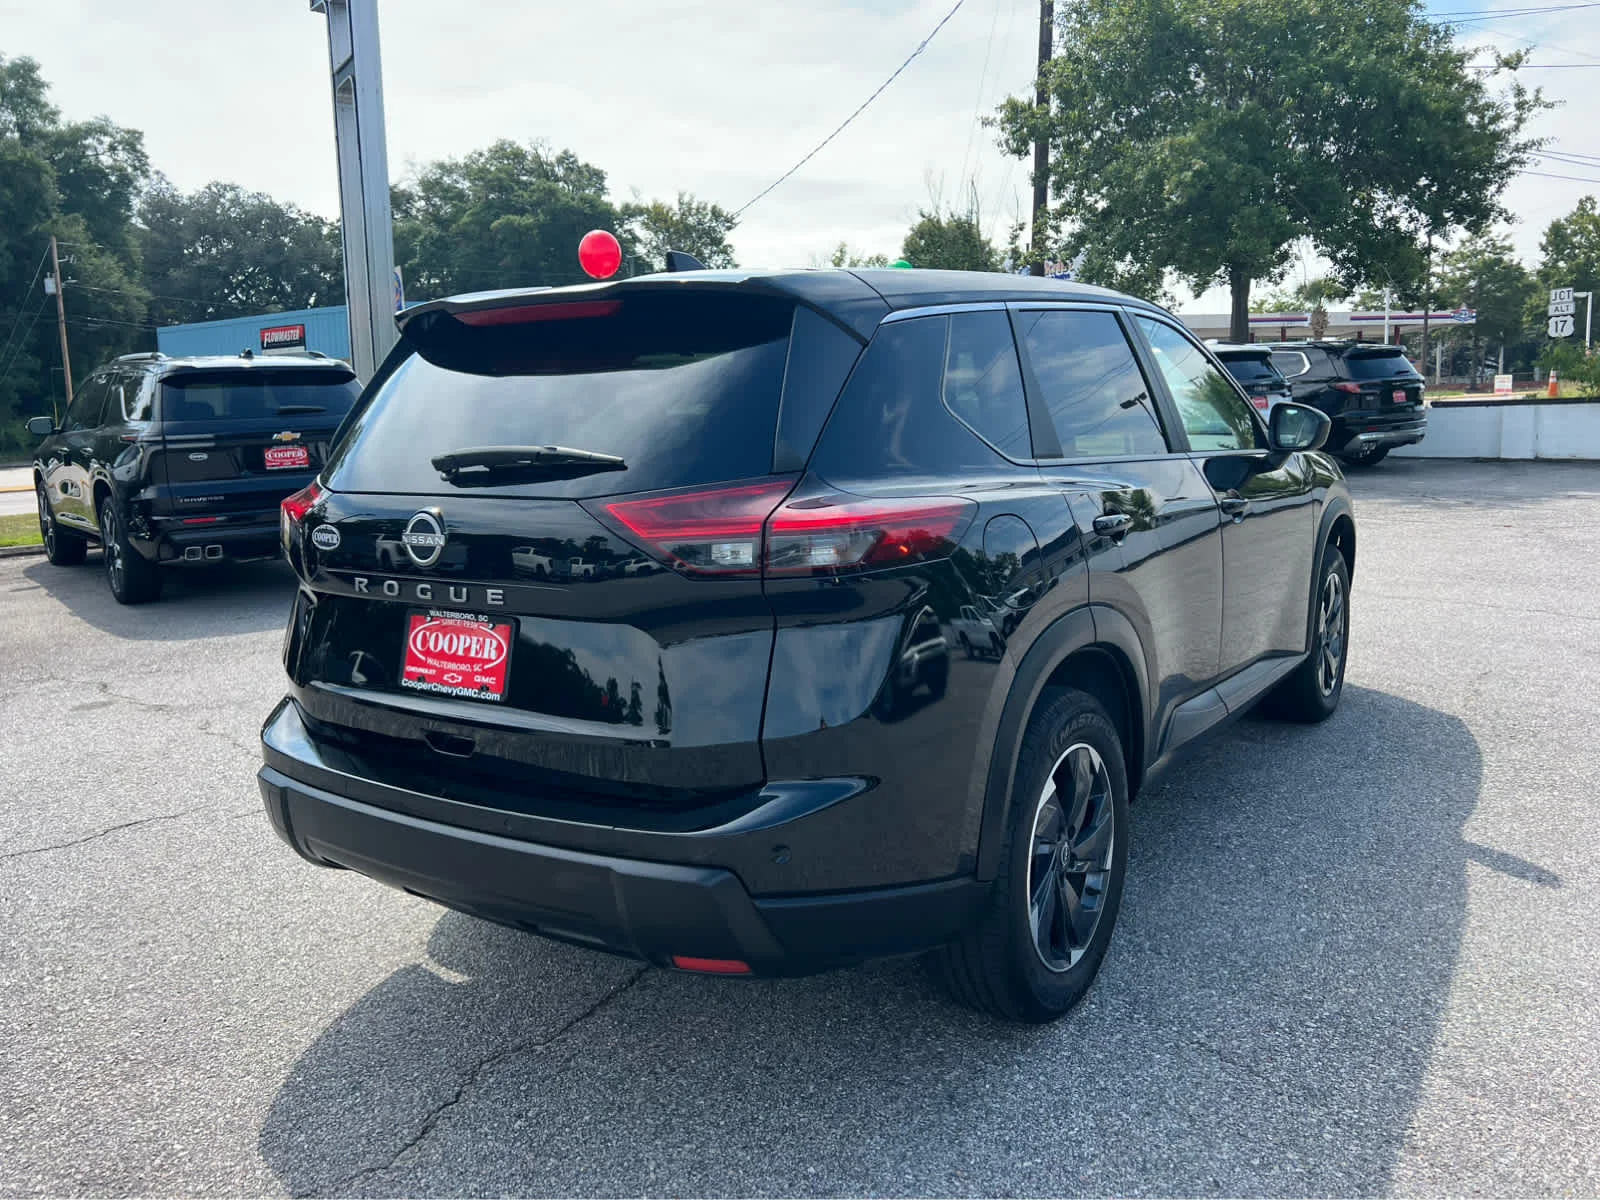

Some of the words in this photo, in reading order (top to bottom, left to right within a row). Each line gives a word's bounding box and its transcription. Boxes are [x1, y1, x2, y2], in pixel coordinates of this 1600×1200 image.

[1552, 290, 1572, 301] JCT
[1555, 320, 1568, 333] 17
[264, 329, 300, 348] FLOWMASTER
[268, 449, 304, 459] COOPER
[314, 531, 339, 544] COOPER
[402, 534, 445, 546] NISSAN
[353, 577, 504, 606] ROGUE
[478, 614, 489, 622] SC
[416, 630, 498, 660] COOPER
[473, 663, 483, 672] SC
[474, 675, 497, 685] GMC
[401, 679, 501, 701] CooperChevyGMC.com
